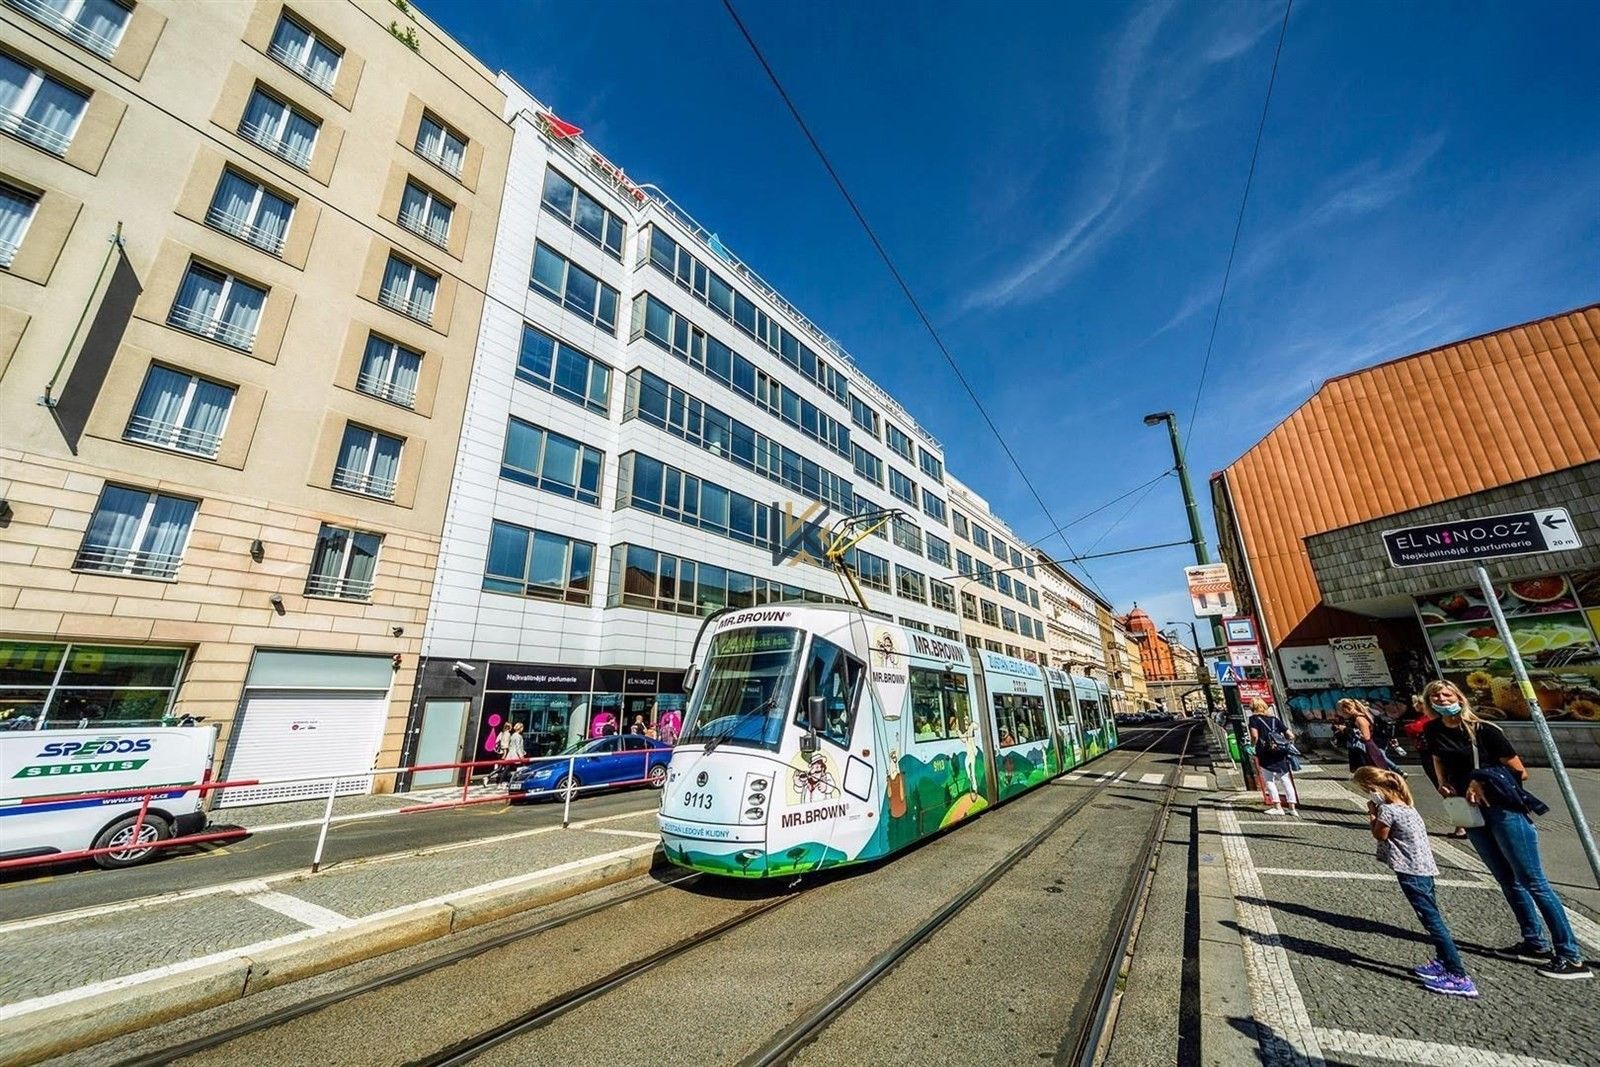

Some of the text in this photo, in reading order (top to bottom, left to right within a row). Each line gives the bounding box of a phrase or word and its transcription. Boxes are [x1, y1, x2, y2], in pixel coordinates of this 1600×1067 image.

[1473, 540, 1532, 553] parfumerie
[36, 738, 152, 758] SPEDOS
[26, 761, 134, 777] SERVIS
[683, 791, 713, 810] 9113
